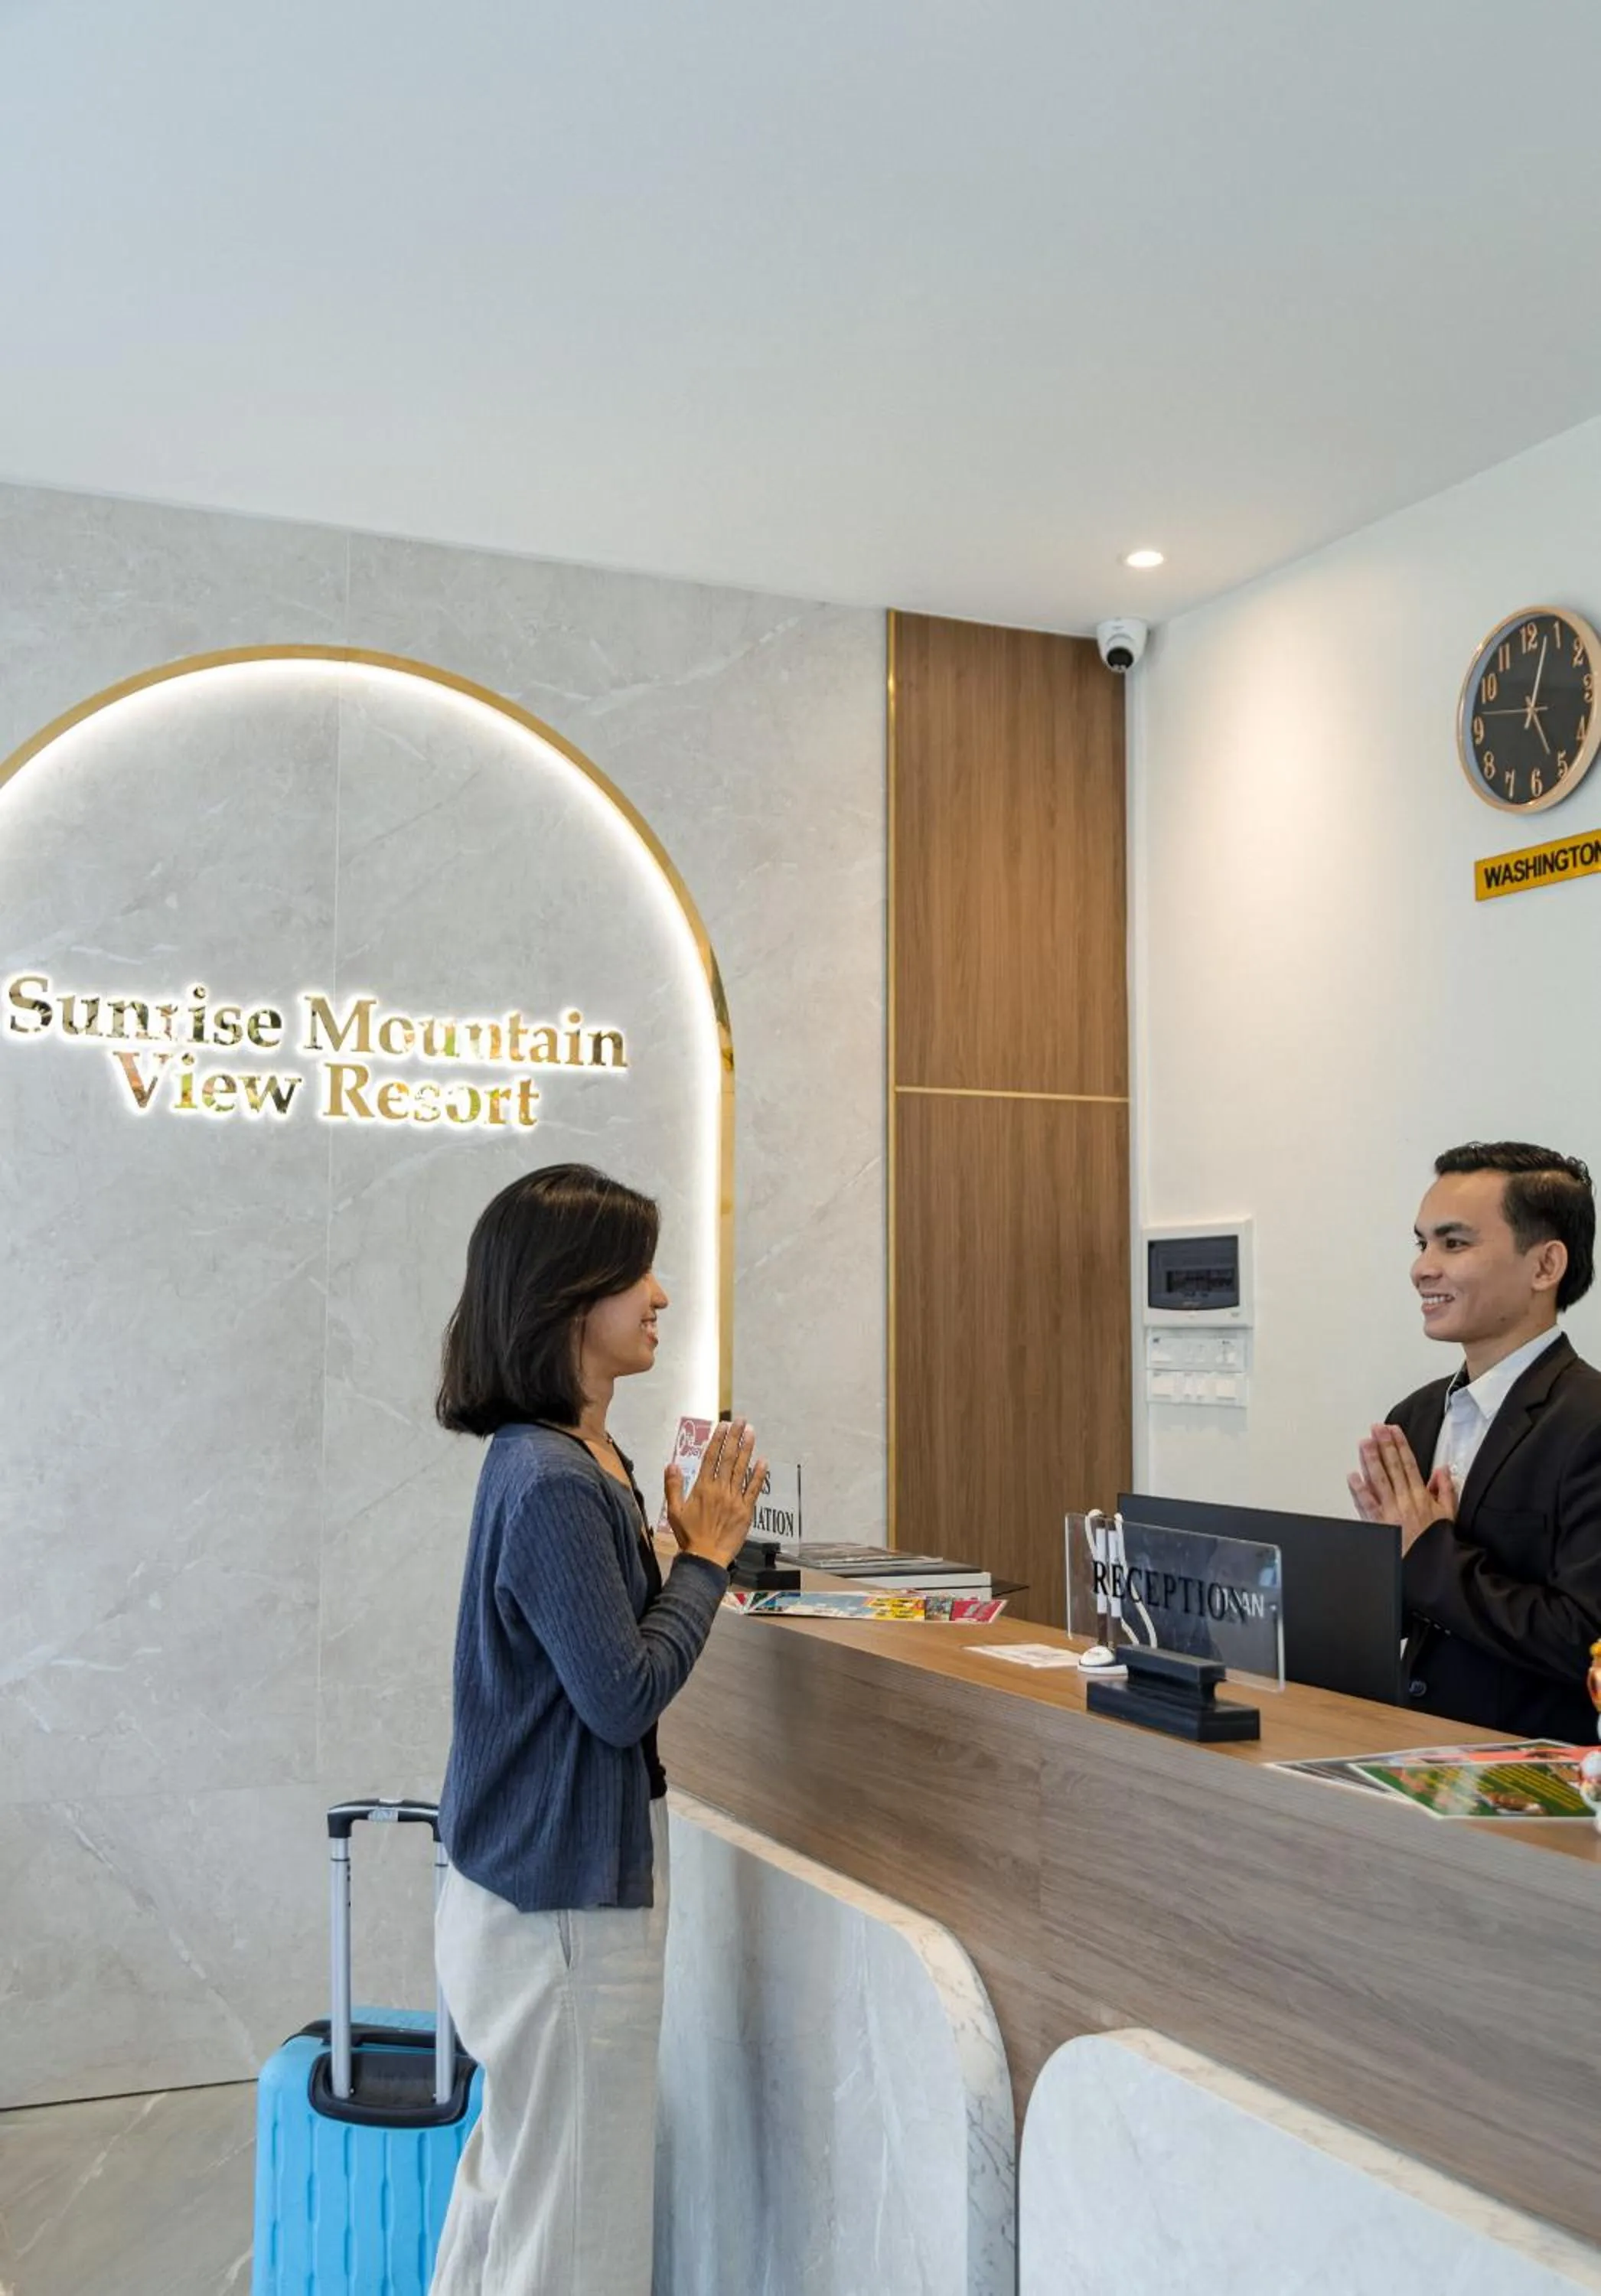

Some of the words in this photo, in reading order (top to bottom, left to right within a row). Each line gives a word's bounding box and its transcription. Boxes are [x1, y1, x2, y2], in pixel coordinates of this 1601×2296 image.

[1519, 622, 1537, 654] 12
[1553, 621, 1560, 650] 1
[1498, 643, 1511, 673] 11
[1573, 638, 1586, 667] 2
[1482, 673, 1498, 703] 10
[1582, 673, 1593, 703] 3
[1473, 716, 1485, 745] 9
[1576, 715, 1586, 742] 4
[1483, 751, 1495, 780] 8
[1557, 750, 1569, 779] 5
[1505, 769, 1515, 798] 7
[1531, 767, 1543, 797] 6
[8, 976, 282, 1048] Sunrise
[303, 996, 629, 1068] Mountain
[112, 1051, 303, 1114] View
[324, 1062, 540, 1125] Resort
[753, 1505, 794, 1538] ATION
[1093, 1560, 1248, 1625] RECEPTION
